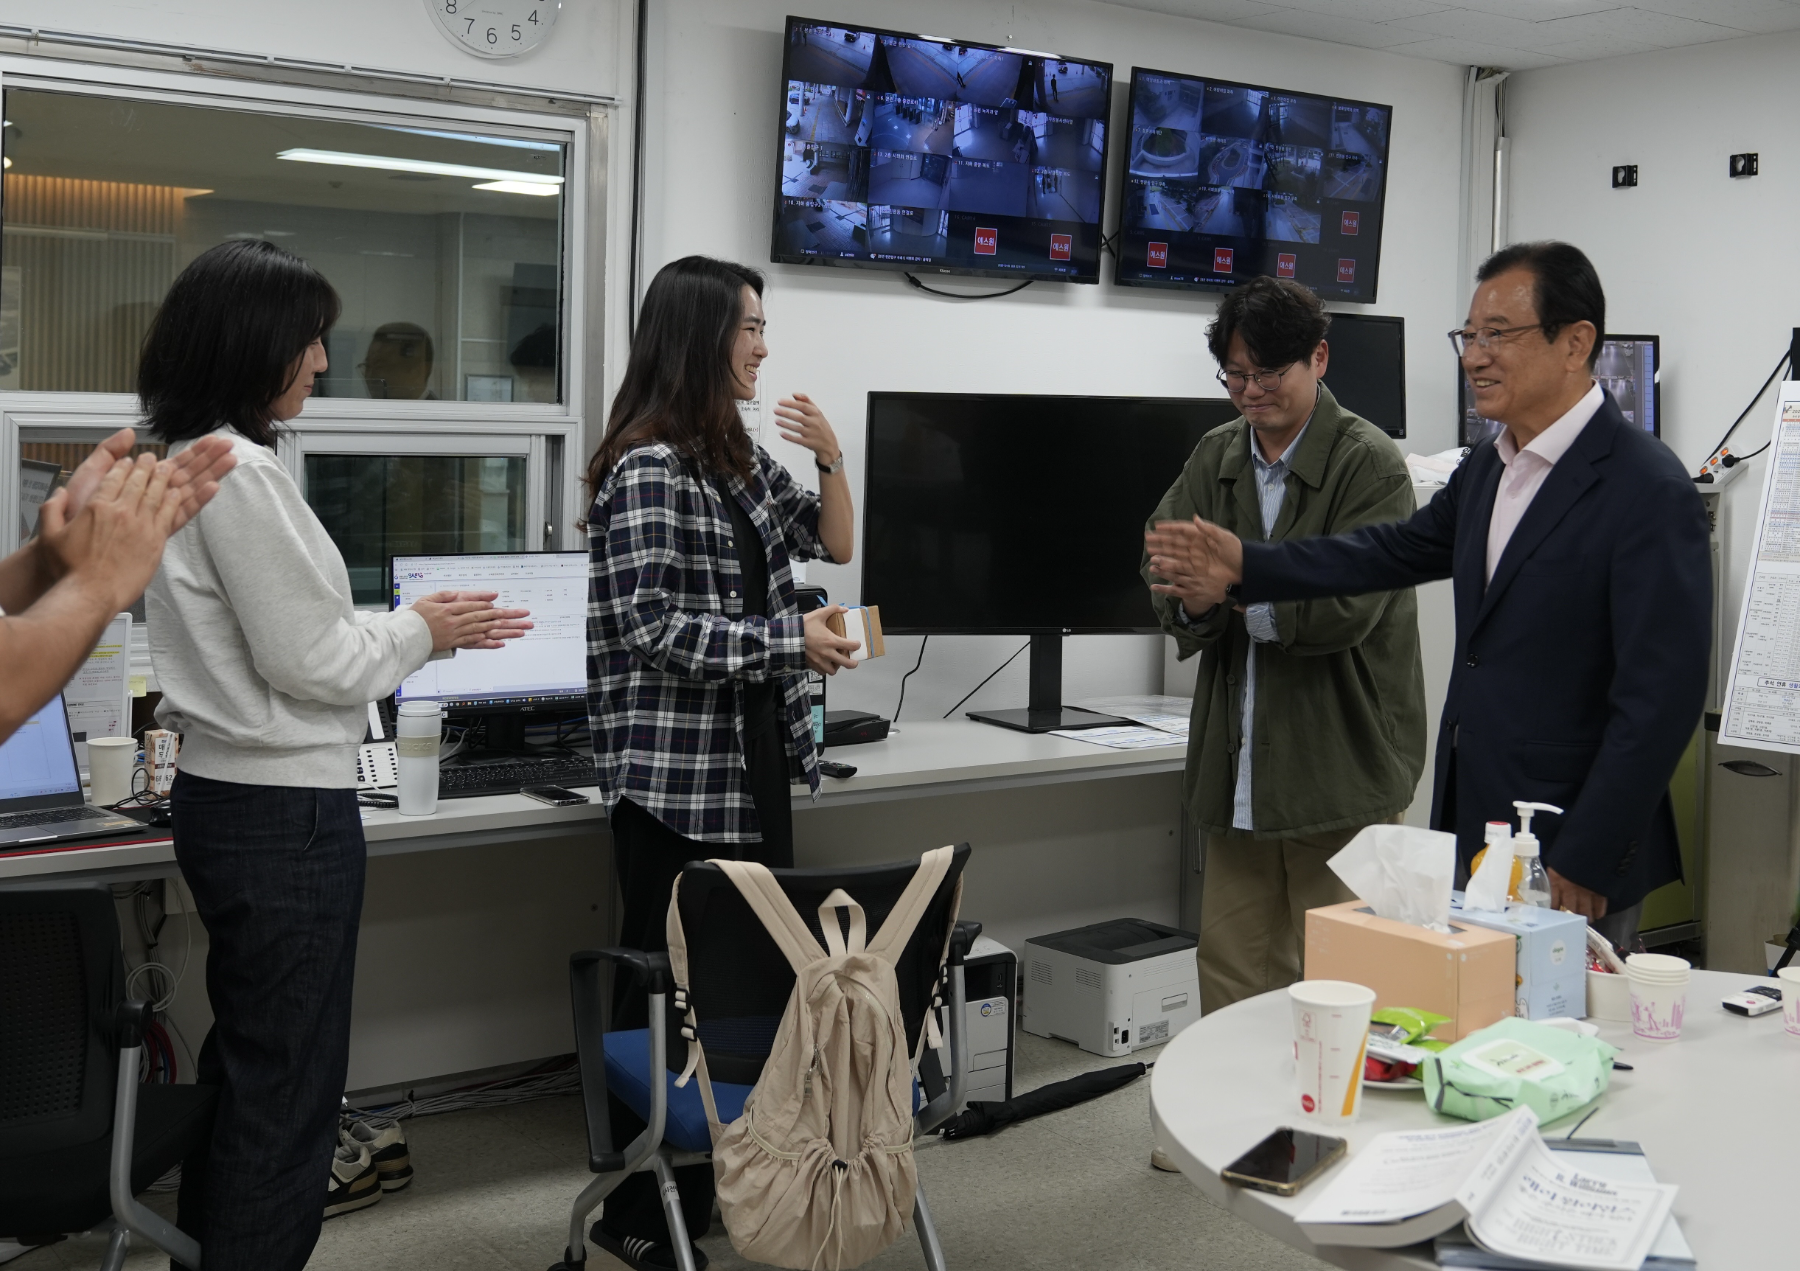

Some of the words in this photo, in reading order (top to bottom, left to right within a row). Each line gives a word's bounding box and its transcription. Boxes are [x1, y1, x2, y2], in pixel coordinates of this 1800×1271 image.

[445, 0, 457, 14] 8
[528, 10, 539, 26] 4
[464, 18, 475, 34] 7
[486, 28, 498, 44] 6
[511, 24, 522, 41] 5
[1344, 219, 1357, 228] 에스원
[976, 235, 995, 246] 에스원
[1052, 241, 1070, 252] 에스원
[1150, 250, 1166, 260] 에스원
[1216, 256, 1231, 265] 에스원
[1280, 260, 1294, 270] 에스원
[1339, 266, 1353, 275] 에스원
